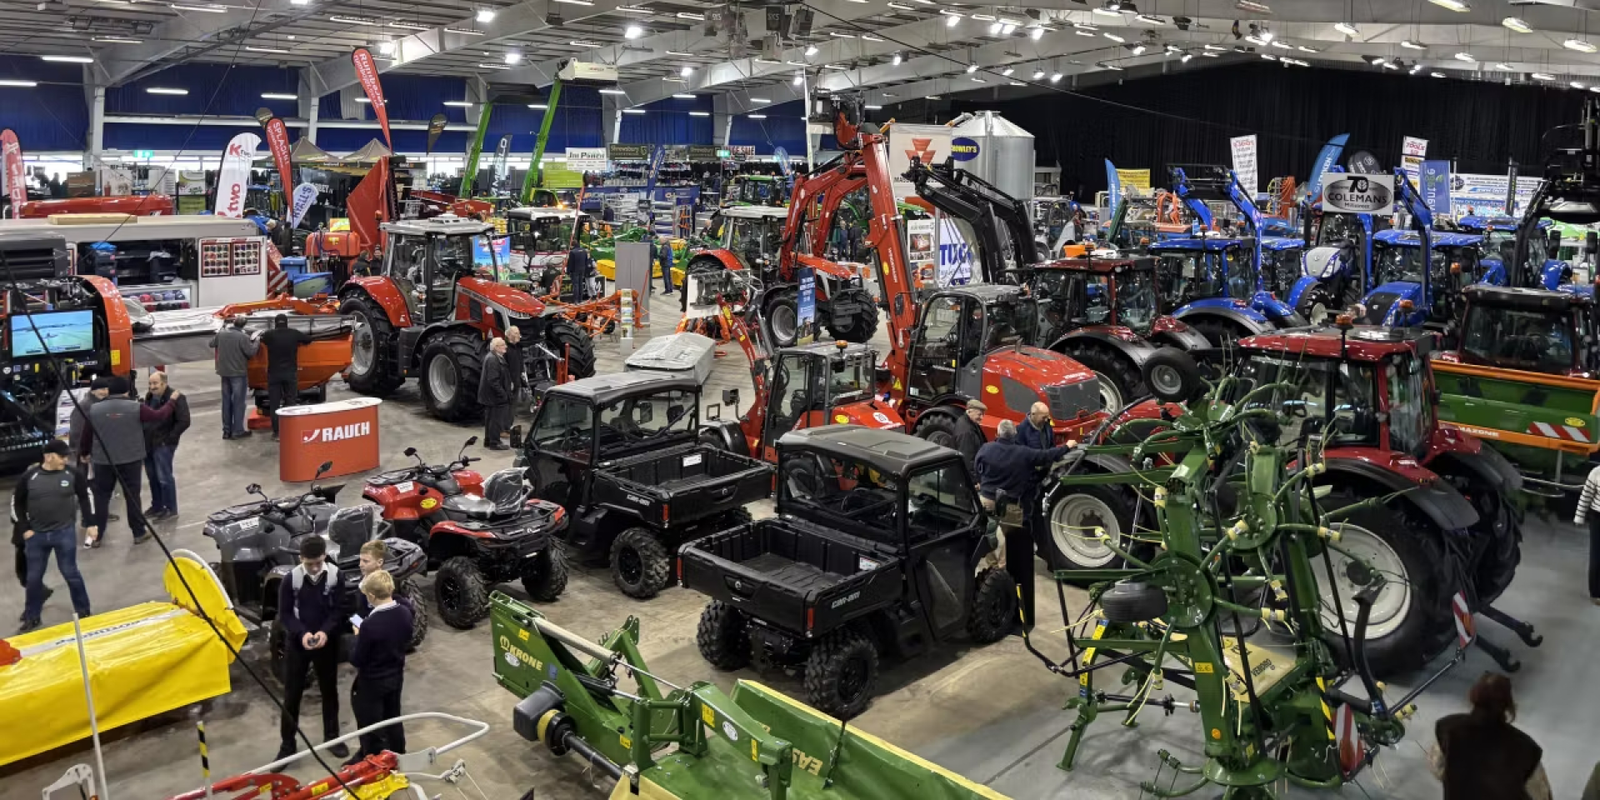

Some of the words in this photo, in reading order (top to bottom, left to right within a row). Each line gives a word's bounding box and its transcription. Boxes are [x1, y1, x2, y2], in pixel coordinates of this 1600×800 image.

[1328, 192, 1387, 204] COLEMANS
[321, 421, 371, 443] RAUCH
[1459, 425, 1500, 438] MAZONE
[509, 643, 544, 672] KRONE
